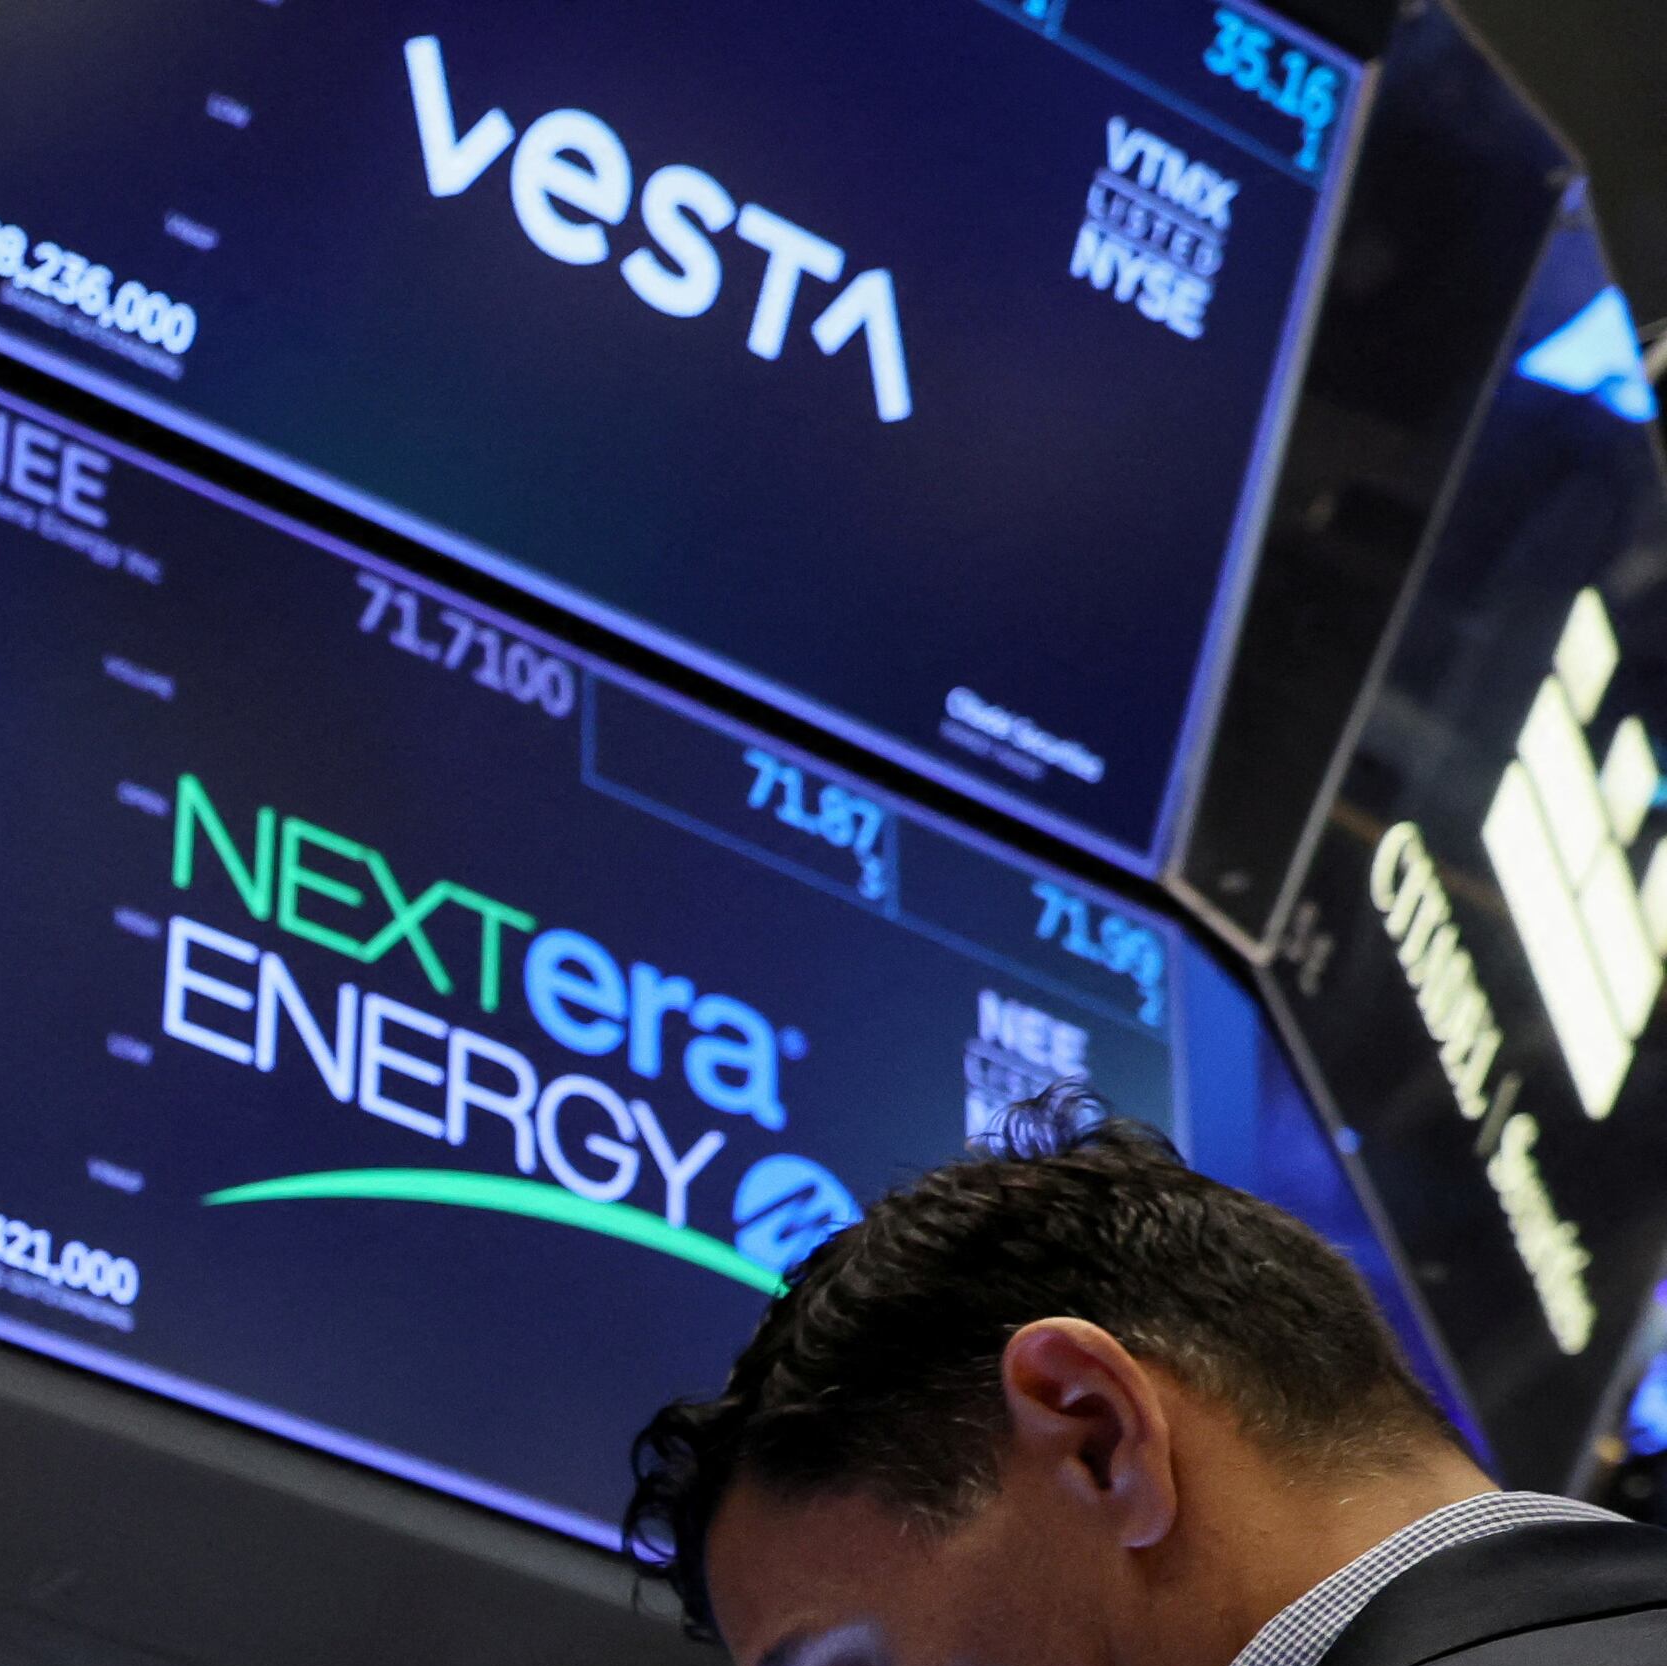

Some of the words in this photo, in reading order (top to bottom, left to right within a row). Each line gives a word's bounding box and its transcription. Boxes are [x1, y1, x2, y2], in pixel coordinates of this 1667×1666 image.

[1203, 8, 1336, 128] 35.16
[1086, 182, 1224, 277] LISTED
[1107, 115, 1239, 230] VTMX
[1070, 220, 1212, 340] NYSE
[354, 574, 576, 719] 71.7100
[743, 748, 882, 848] 71.87
[164, 915, 727, 1228] ENERGY
